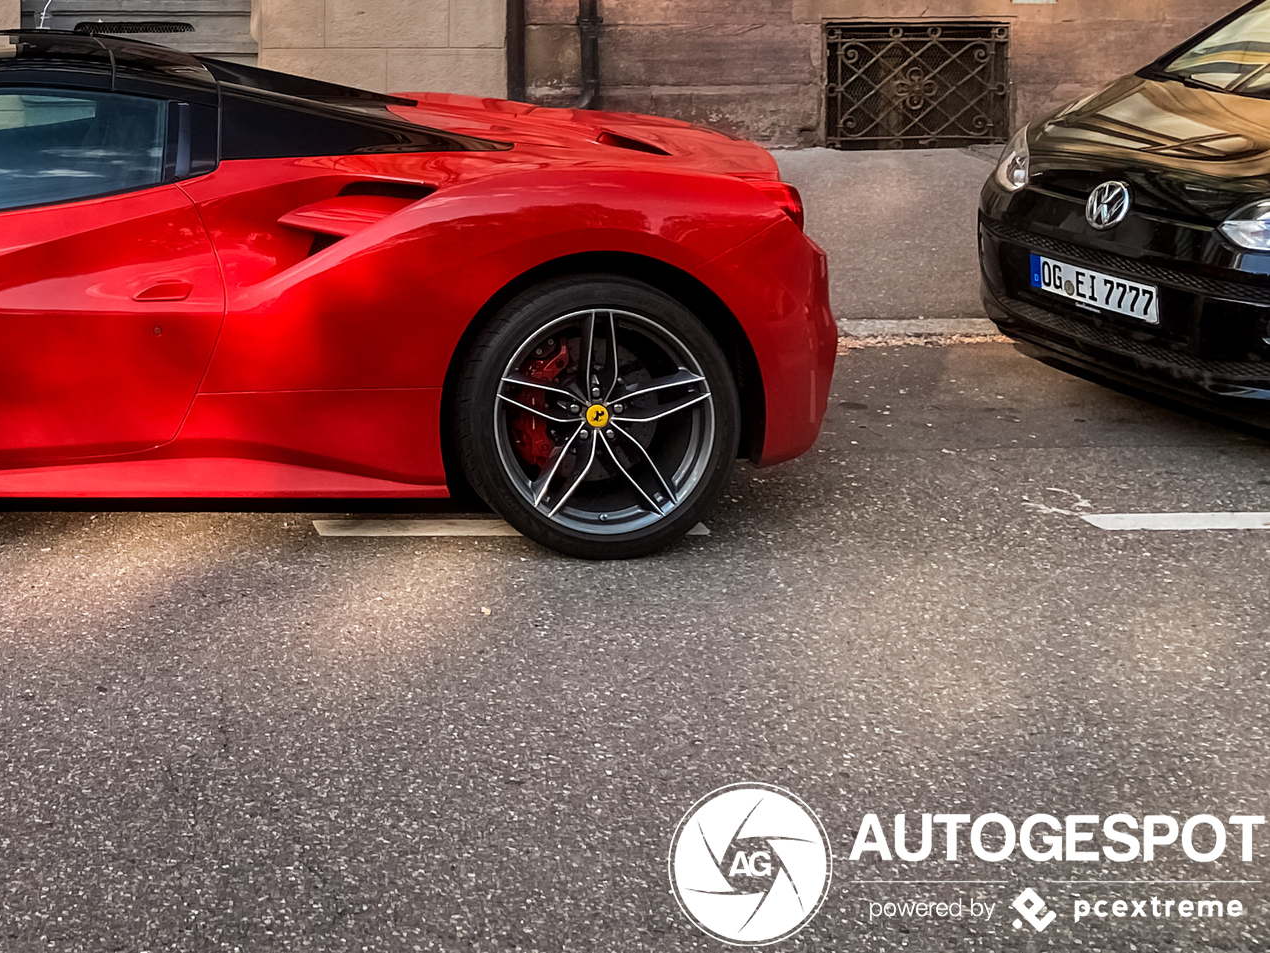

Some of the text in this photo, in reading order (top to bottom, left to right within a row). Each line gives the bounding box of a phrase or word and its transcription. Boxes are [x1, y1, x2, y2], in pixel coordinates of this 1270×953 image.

[1042, 260, 1063, 290] OG
[1075, 270, 1098, 302] EI
[1103, 278, 1154, 316] 7777
